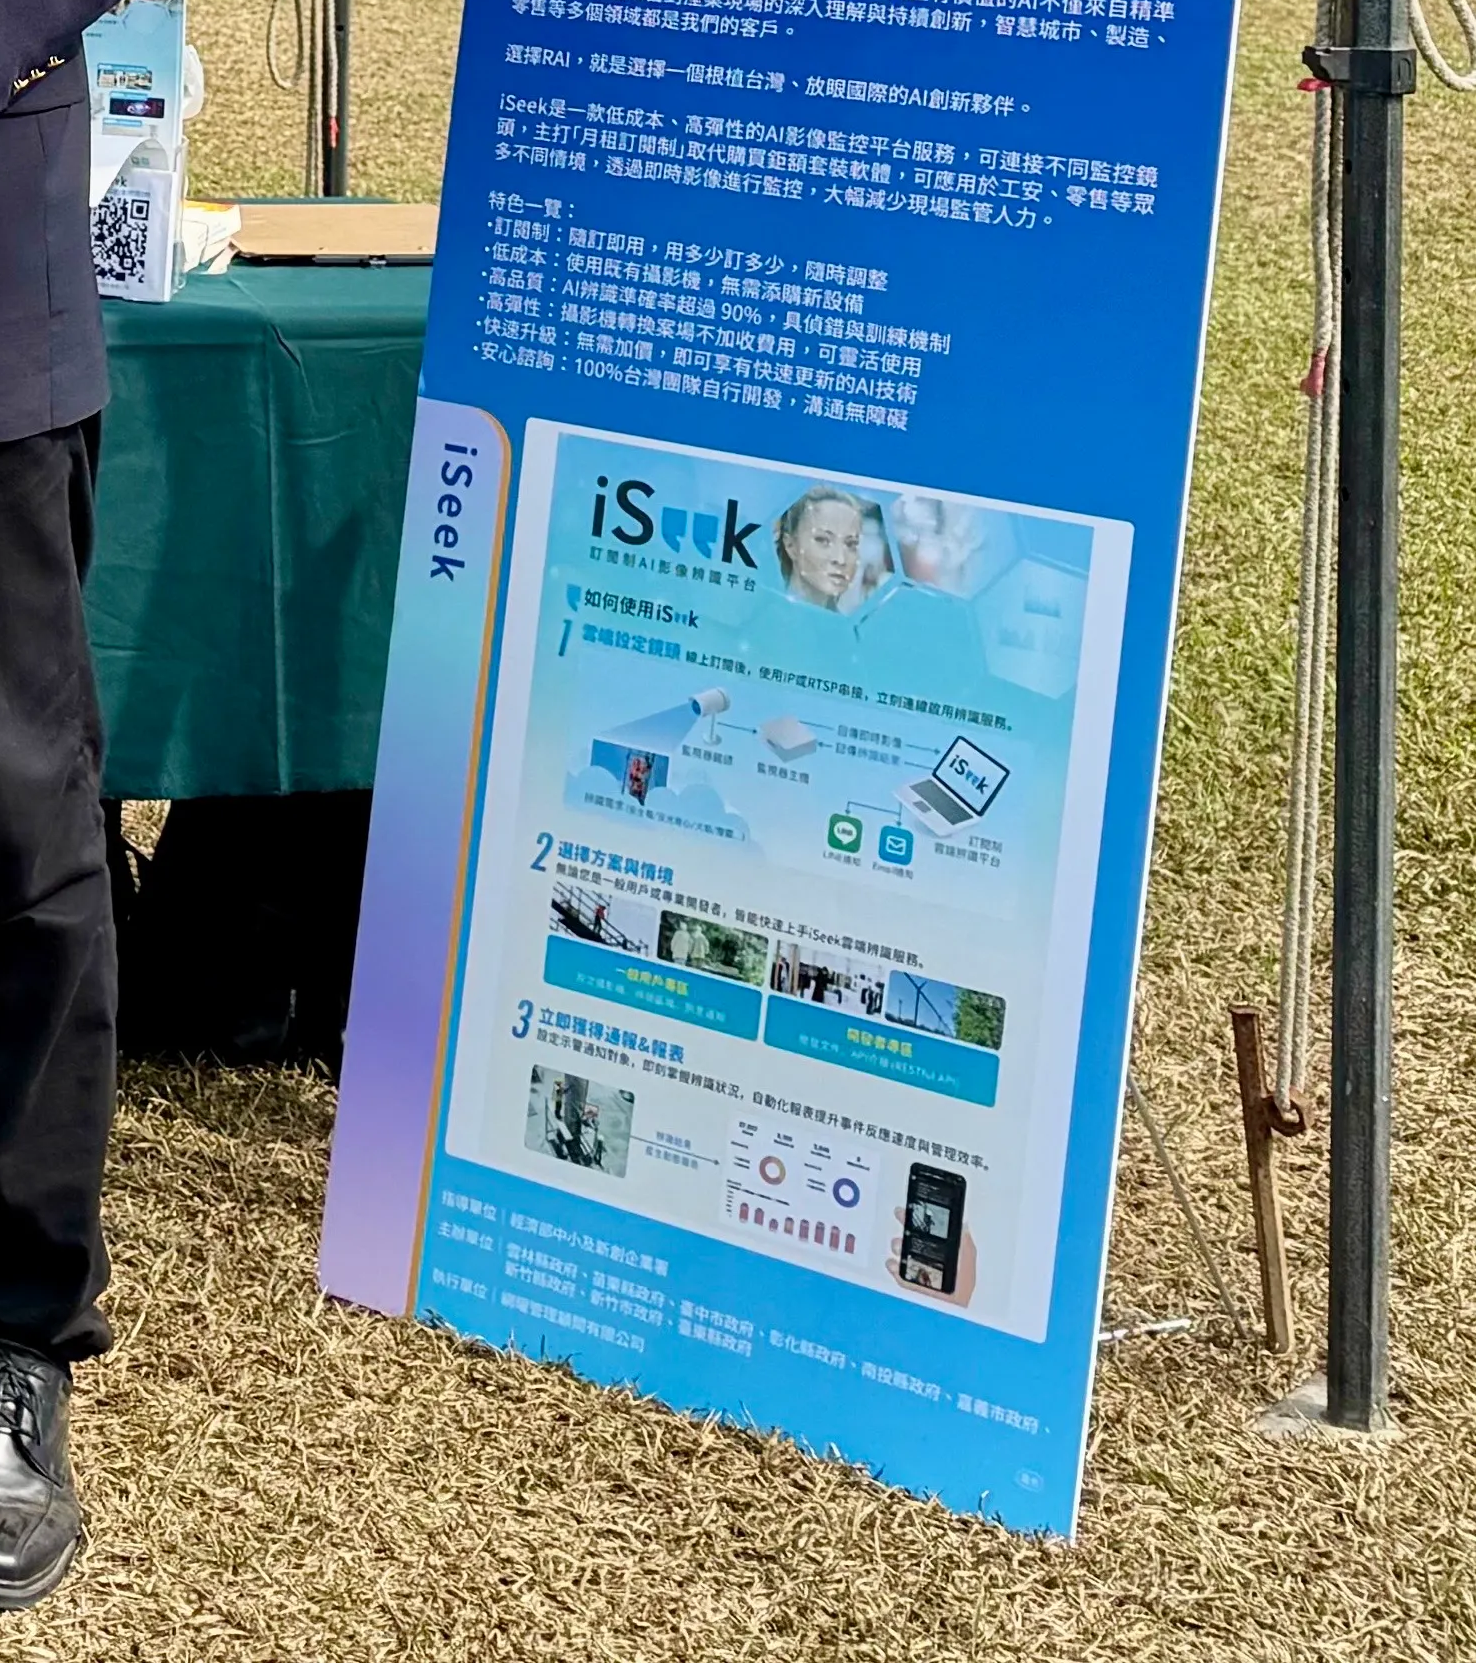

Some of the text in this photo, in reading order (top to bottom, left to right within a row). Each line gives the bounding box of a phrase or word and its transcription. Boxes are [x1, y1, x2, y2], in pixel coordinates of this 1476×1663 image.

[429, 442, 479, 583] iSeek
[557, 618, 573, 658] 1
[530, 831, 554, 873] 2
[511, 998, 535, 1040] 3
